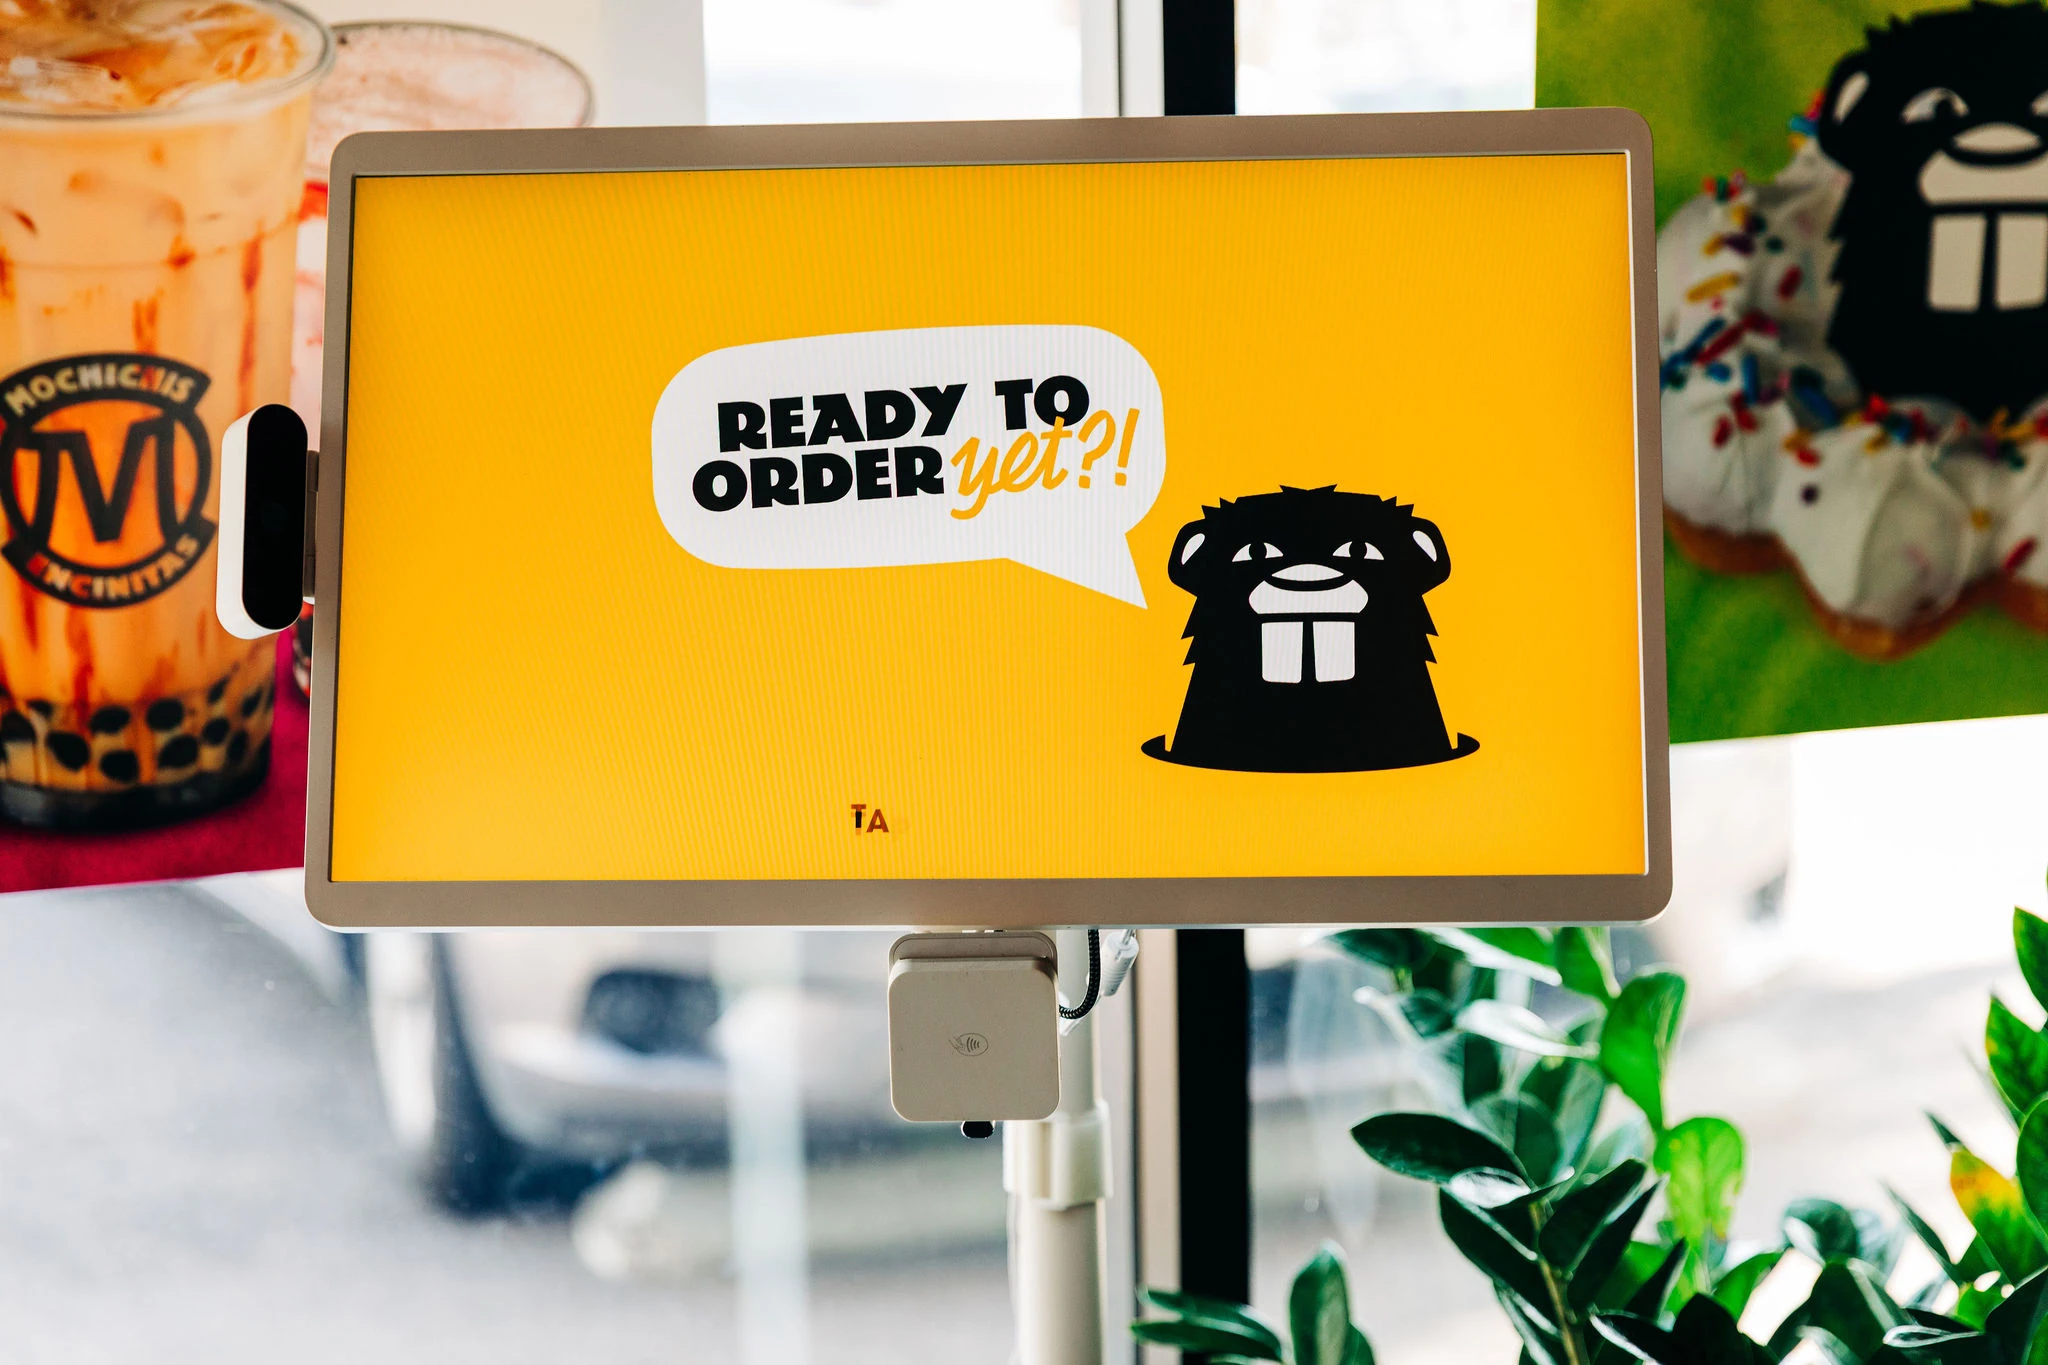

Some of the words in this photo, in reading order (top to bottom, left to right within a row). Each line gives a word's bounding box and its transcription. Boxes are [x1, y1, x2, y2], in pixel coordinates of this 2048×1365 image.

[718, 384, 968, 452] READY
[995, 375, 1090, 431] TO
[692, 445, 945, 512] ORDER
[950, 407, 1140, 519] yet?!
